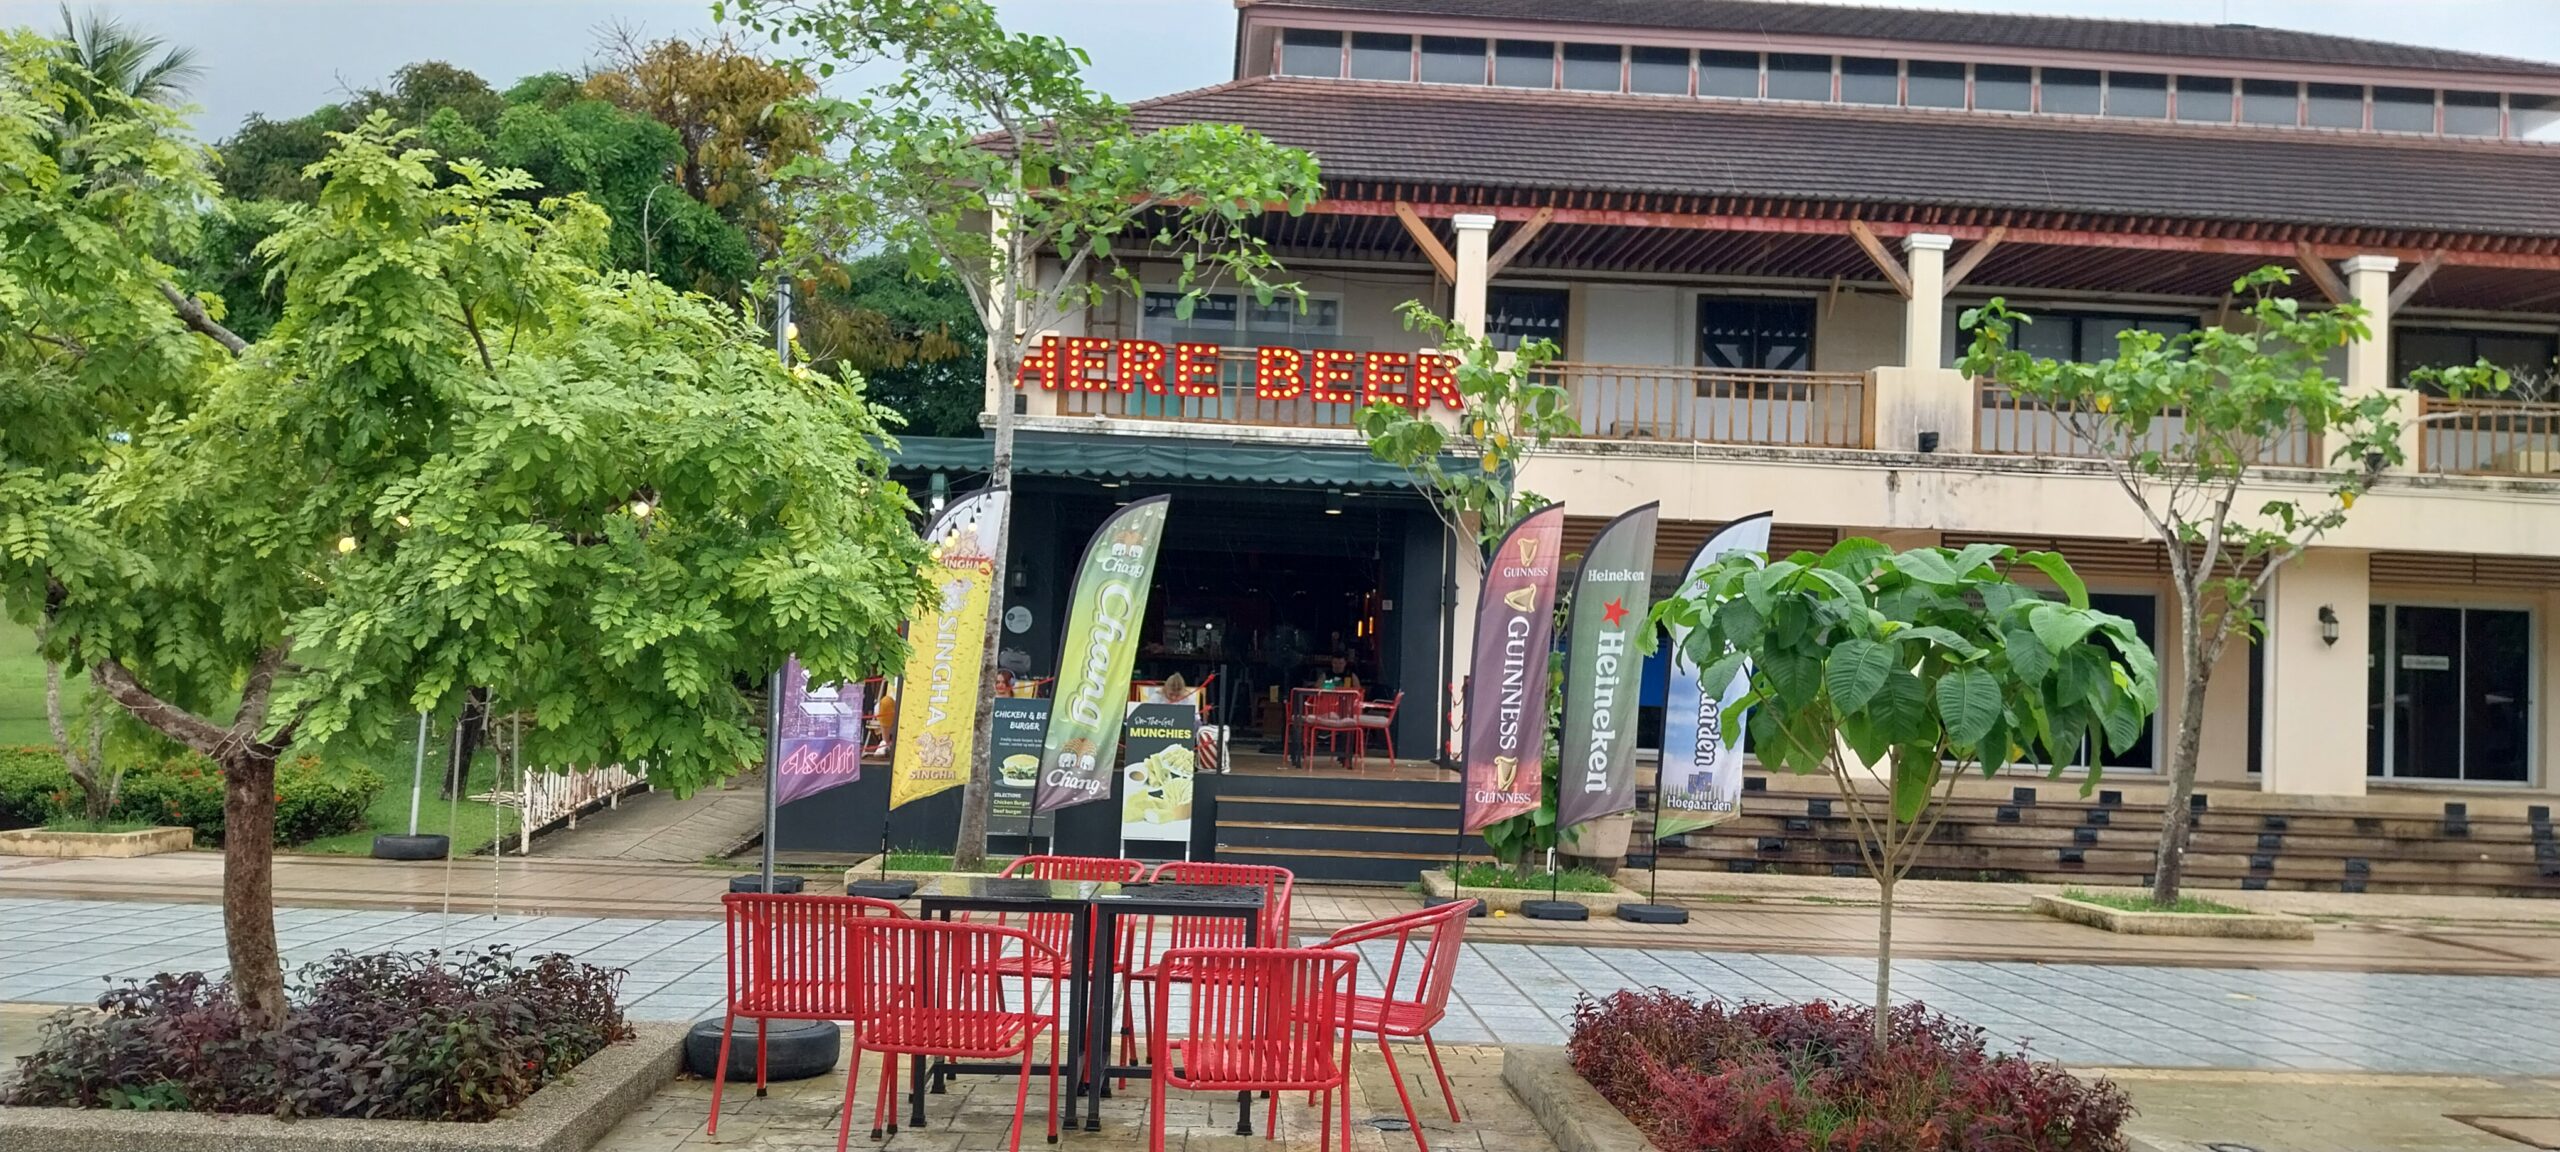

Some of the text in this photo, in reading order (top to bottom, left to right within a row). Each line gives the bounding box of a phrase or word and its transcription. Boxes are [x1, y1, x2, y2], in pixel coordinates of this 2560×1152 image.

[1256, 345, 1465, 410] BEER
[1101, 556, 1145, 578] Chang
[1503, 566, 1549, 578] GUINNESS
[1587, 568, 1645, 582] Heineken
[1068, 580, 1135, 730] Chang
[925, 615, 959, 728] SINGHA
[1498, 615, 1530, 750] GUINNESS
[994, 710, 1048, 720] CHICKEN & BE
[1584, 629, 1626, 794] Heineken
[1010, 721, 1041, 731] BURGER
[1129, 727, 1192, 739] MUNCHIES
[781, 743, 855, 775] Asahi
[909, 768, 956, 780] SINGHA
[1046, 768, 1101, 796] Chang
[1474, 789, 1532, 804] GUINNESS
[1666, 794, 1732, 812] Hoegaarden
